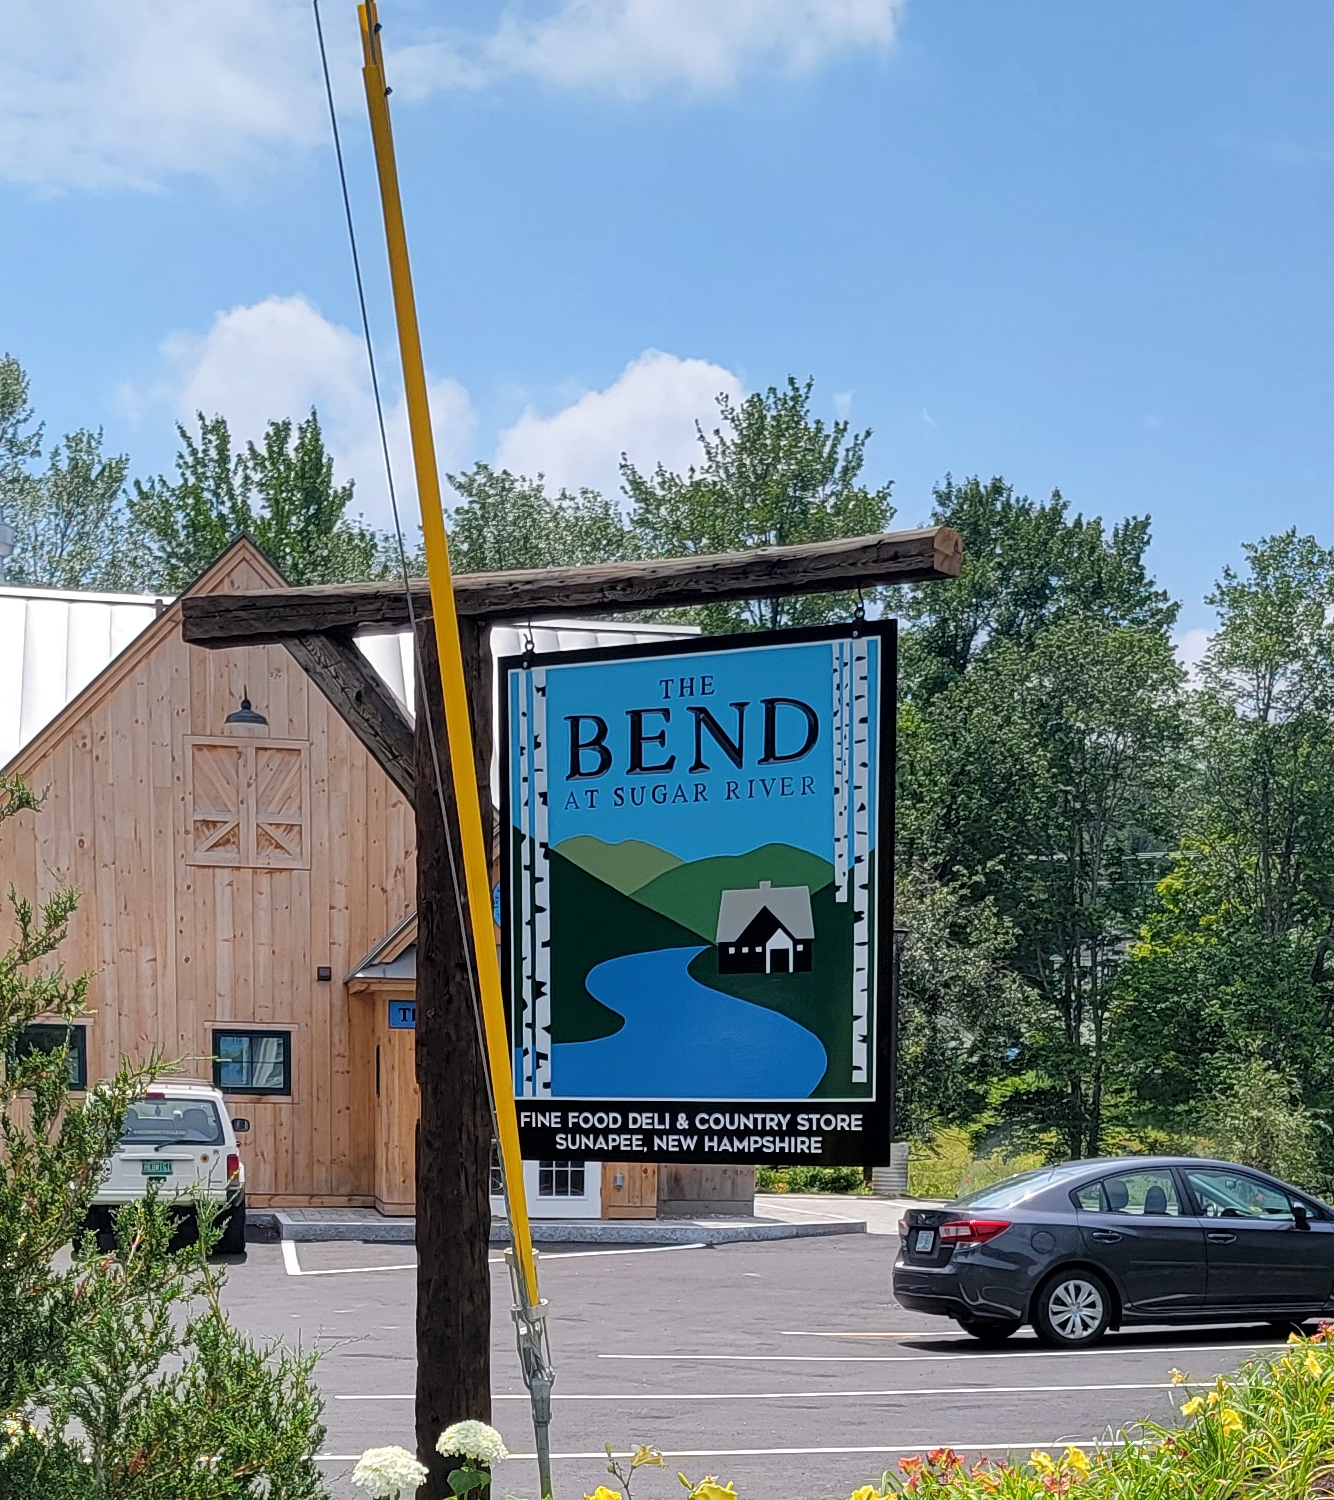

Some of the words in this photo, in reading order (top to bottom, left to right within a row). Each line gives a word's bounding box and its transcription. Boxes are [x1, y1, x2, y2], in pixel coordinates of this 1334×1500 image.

[659, 675, 716, 699] THE
[564, 697, 820, 782] BEND
[564, 789, 599, 810] AT
[613, 782, 709, 807] SUGAR
[725, 775, 816, 801] RIVER
[520, 1111, 562, 1128] FINE
[568, 1111, 622, 1129] FOOD
[628, 1112, 670, 1129] DELI
[676, 1112, 689, 1130] &
[695, 1112, 791, 1131] COUNTRY
[797, 1113, 863, 1131] STORE
[555, 1133, 648, 1153] SUNAPEE,
[654, 1134, 698, 1151] NEW
[704, 1135, 823, 1154] HAMPSHIRE
